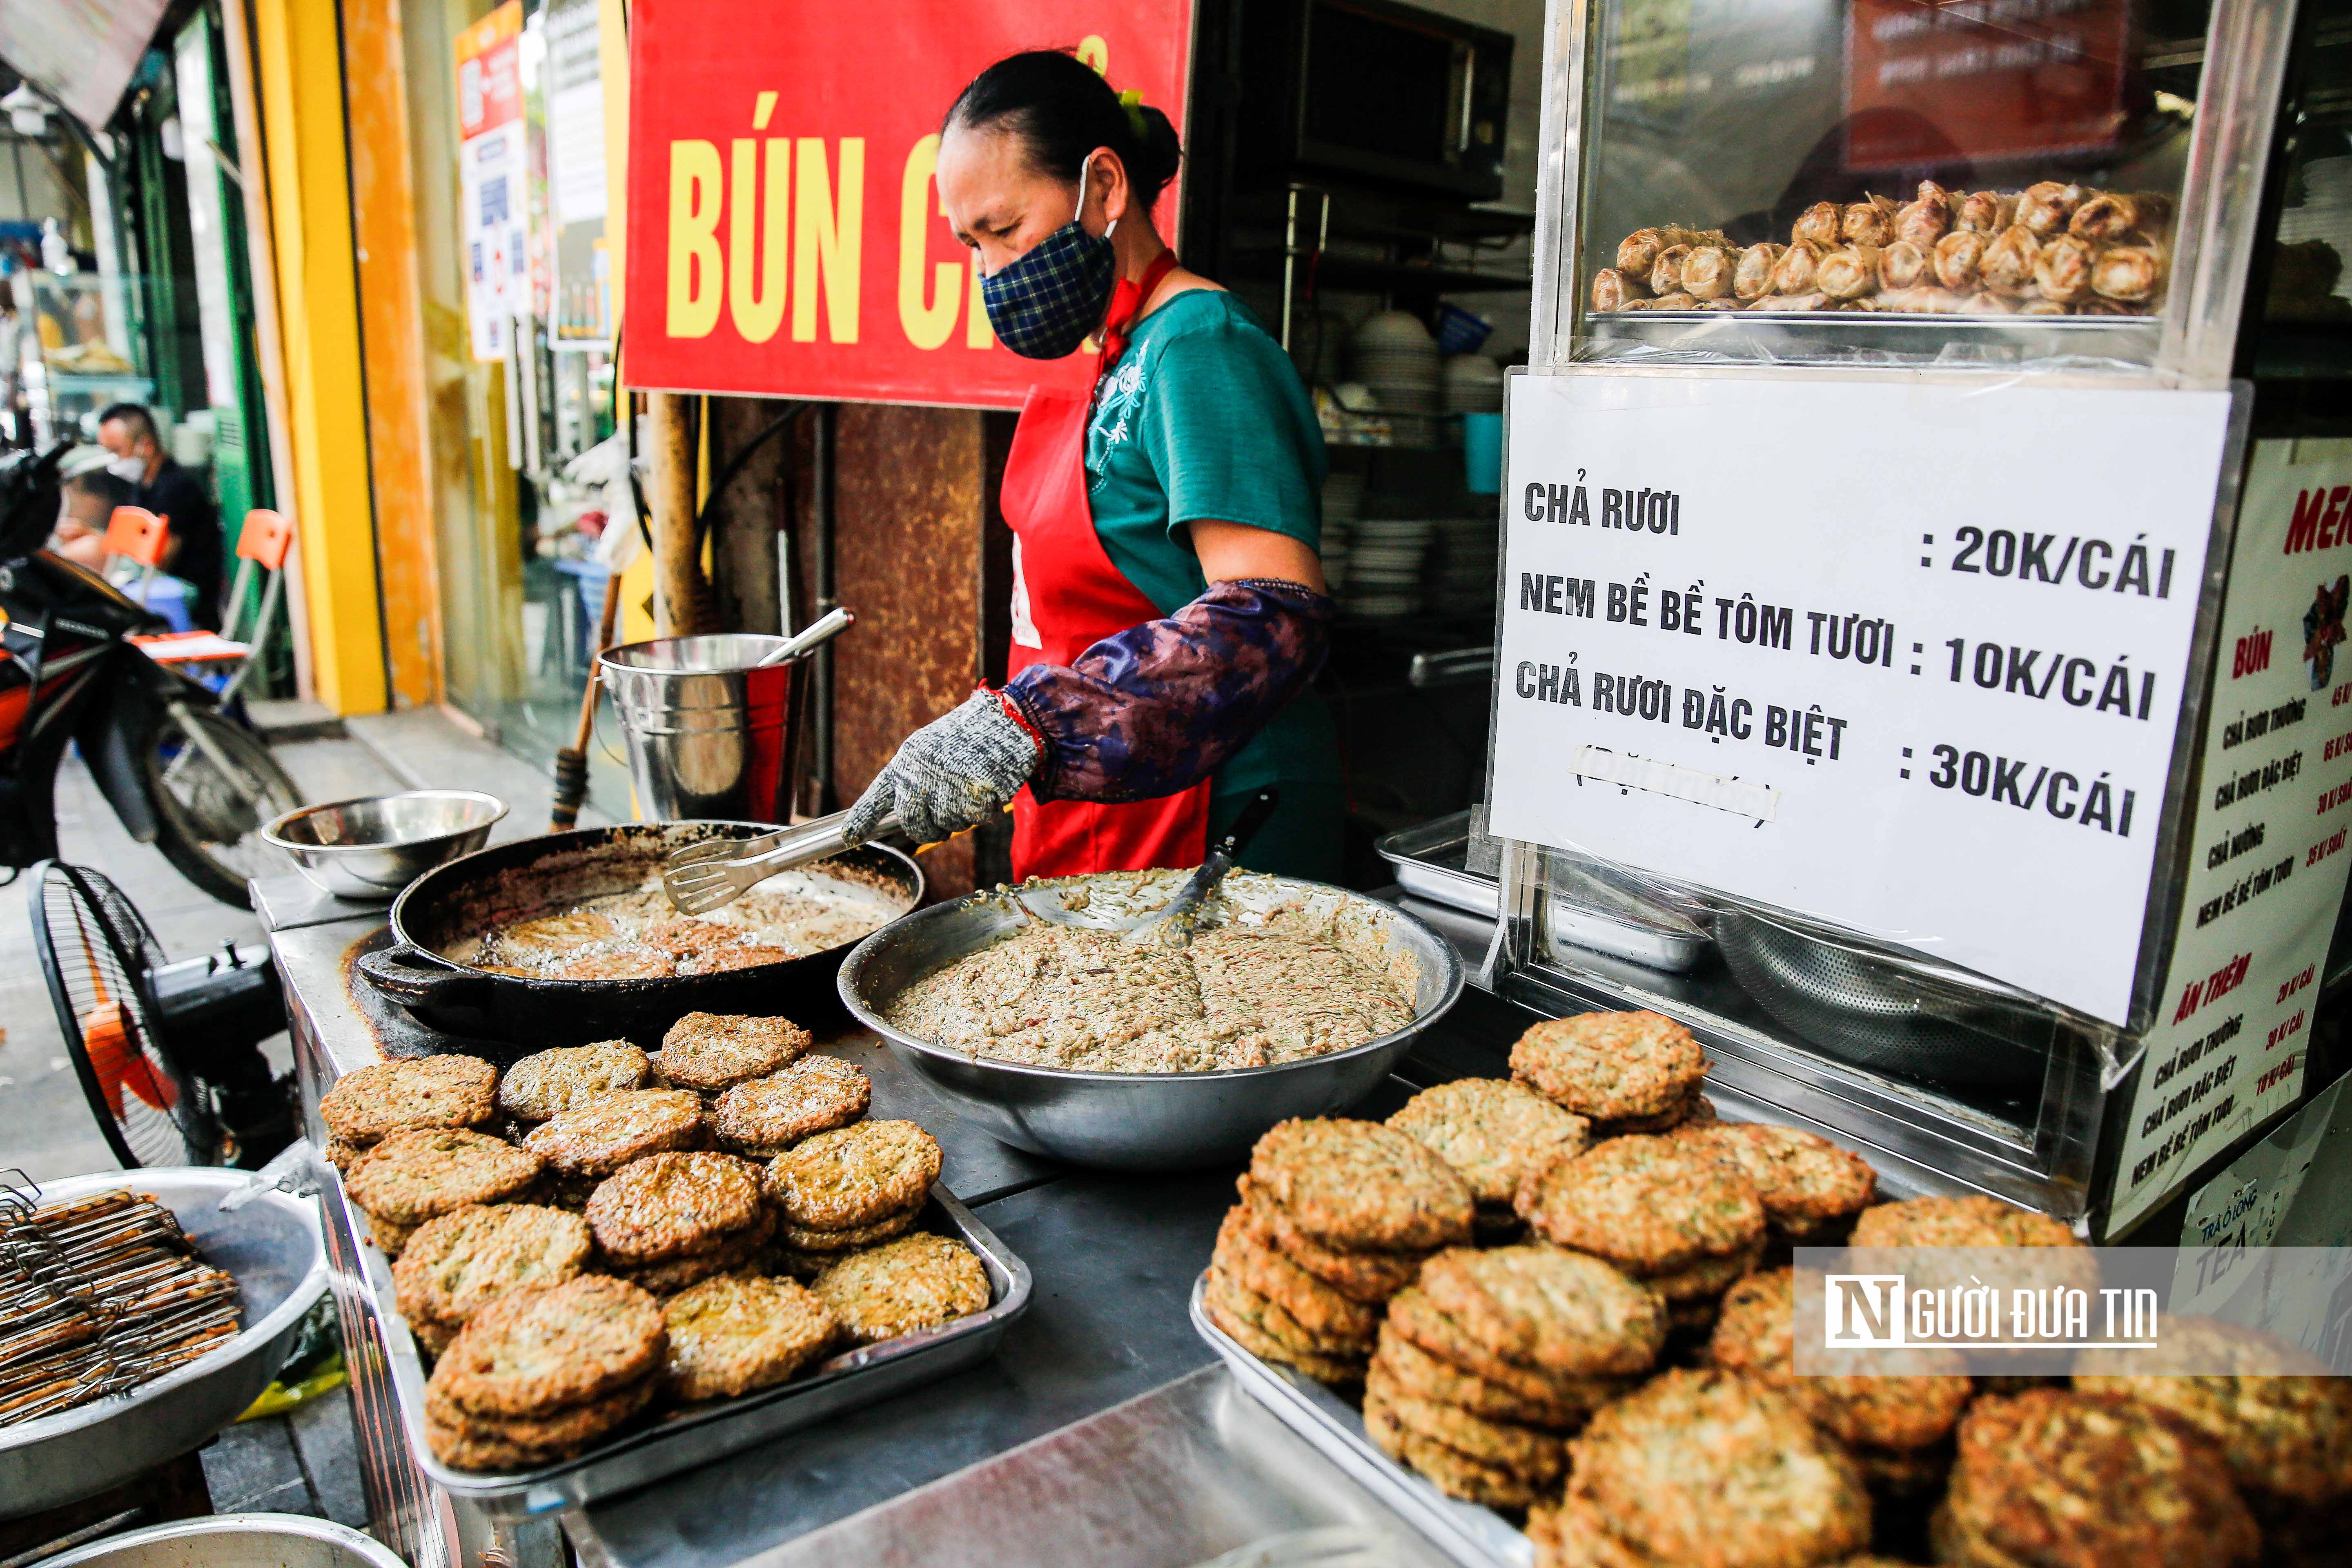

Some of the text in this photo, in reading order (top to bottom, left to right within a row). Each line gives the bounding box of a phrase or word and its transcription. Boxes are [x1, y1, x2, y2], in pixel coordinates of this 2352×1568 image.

[665, 90, 865, 345] BÚN
[1524, 468, 1590, 526] CHẢ
[1601, 488, 1680, 536] RƯƠI
[1951, 526, 2176, 599] 20K/CÁI
[1521, 572, 1595, 619] NEM
[1607, 572, 1650, 626] BỀ
[1660, 579, 1704, 635] BỀ
[1715, 593, 1793, 650] TÔM
[1806, 610, 1894, 668] TƯƠI
[1946, 637, 2156, 721] 10K/CÁI
[2232, 624, 2273, 680] BÚN
[1516, 651, 1582, 708] CHẢ
[1592, 673, 1672, 724] RƯƠI
[1682, 686, 1753, 744] ĐẶC
[1765, 704, 1848, 766] BIỆT
[1929, 744, 2136, 838] 30K/CÁI
[2282, 749, 2303, 781] BIỆT
[2196, 895, 2223, 929] NEM
[2172, 951, 2252, 1027] ĂN THÊM
[2141, 1096, 2166, 1138] CHẢ
[2191, 1069, 2214, 1104] ĐẶC
[2214, 1054, 2238, 1088] BIỆT
[2153, 1046, 2179, 1090] CHẢ
[2131, 1150, 2157, 1188] NEM
[2189, 1111, 2212, 1143] TÔM
[2266, 1192, 2279, 1240] PLUS
